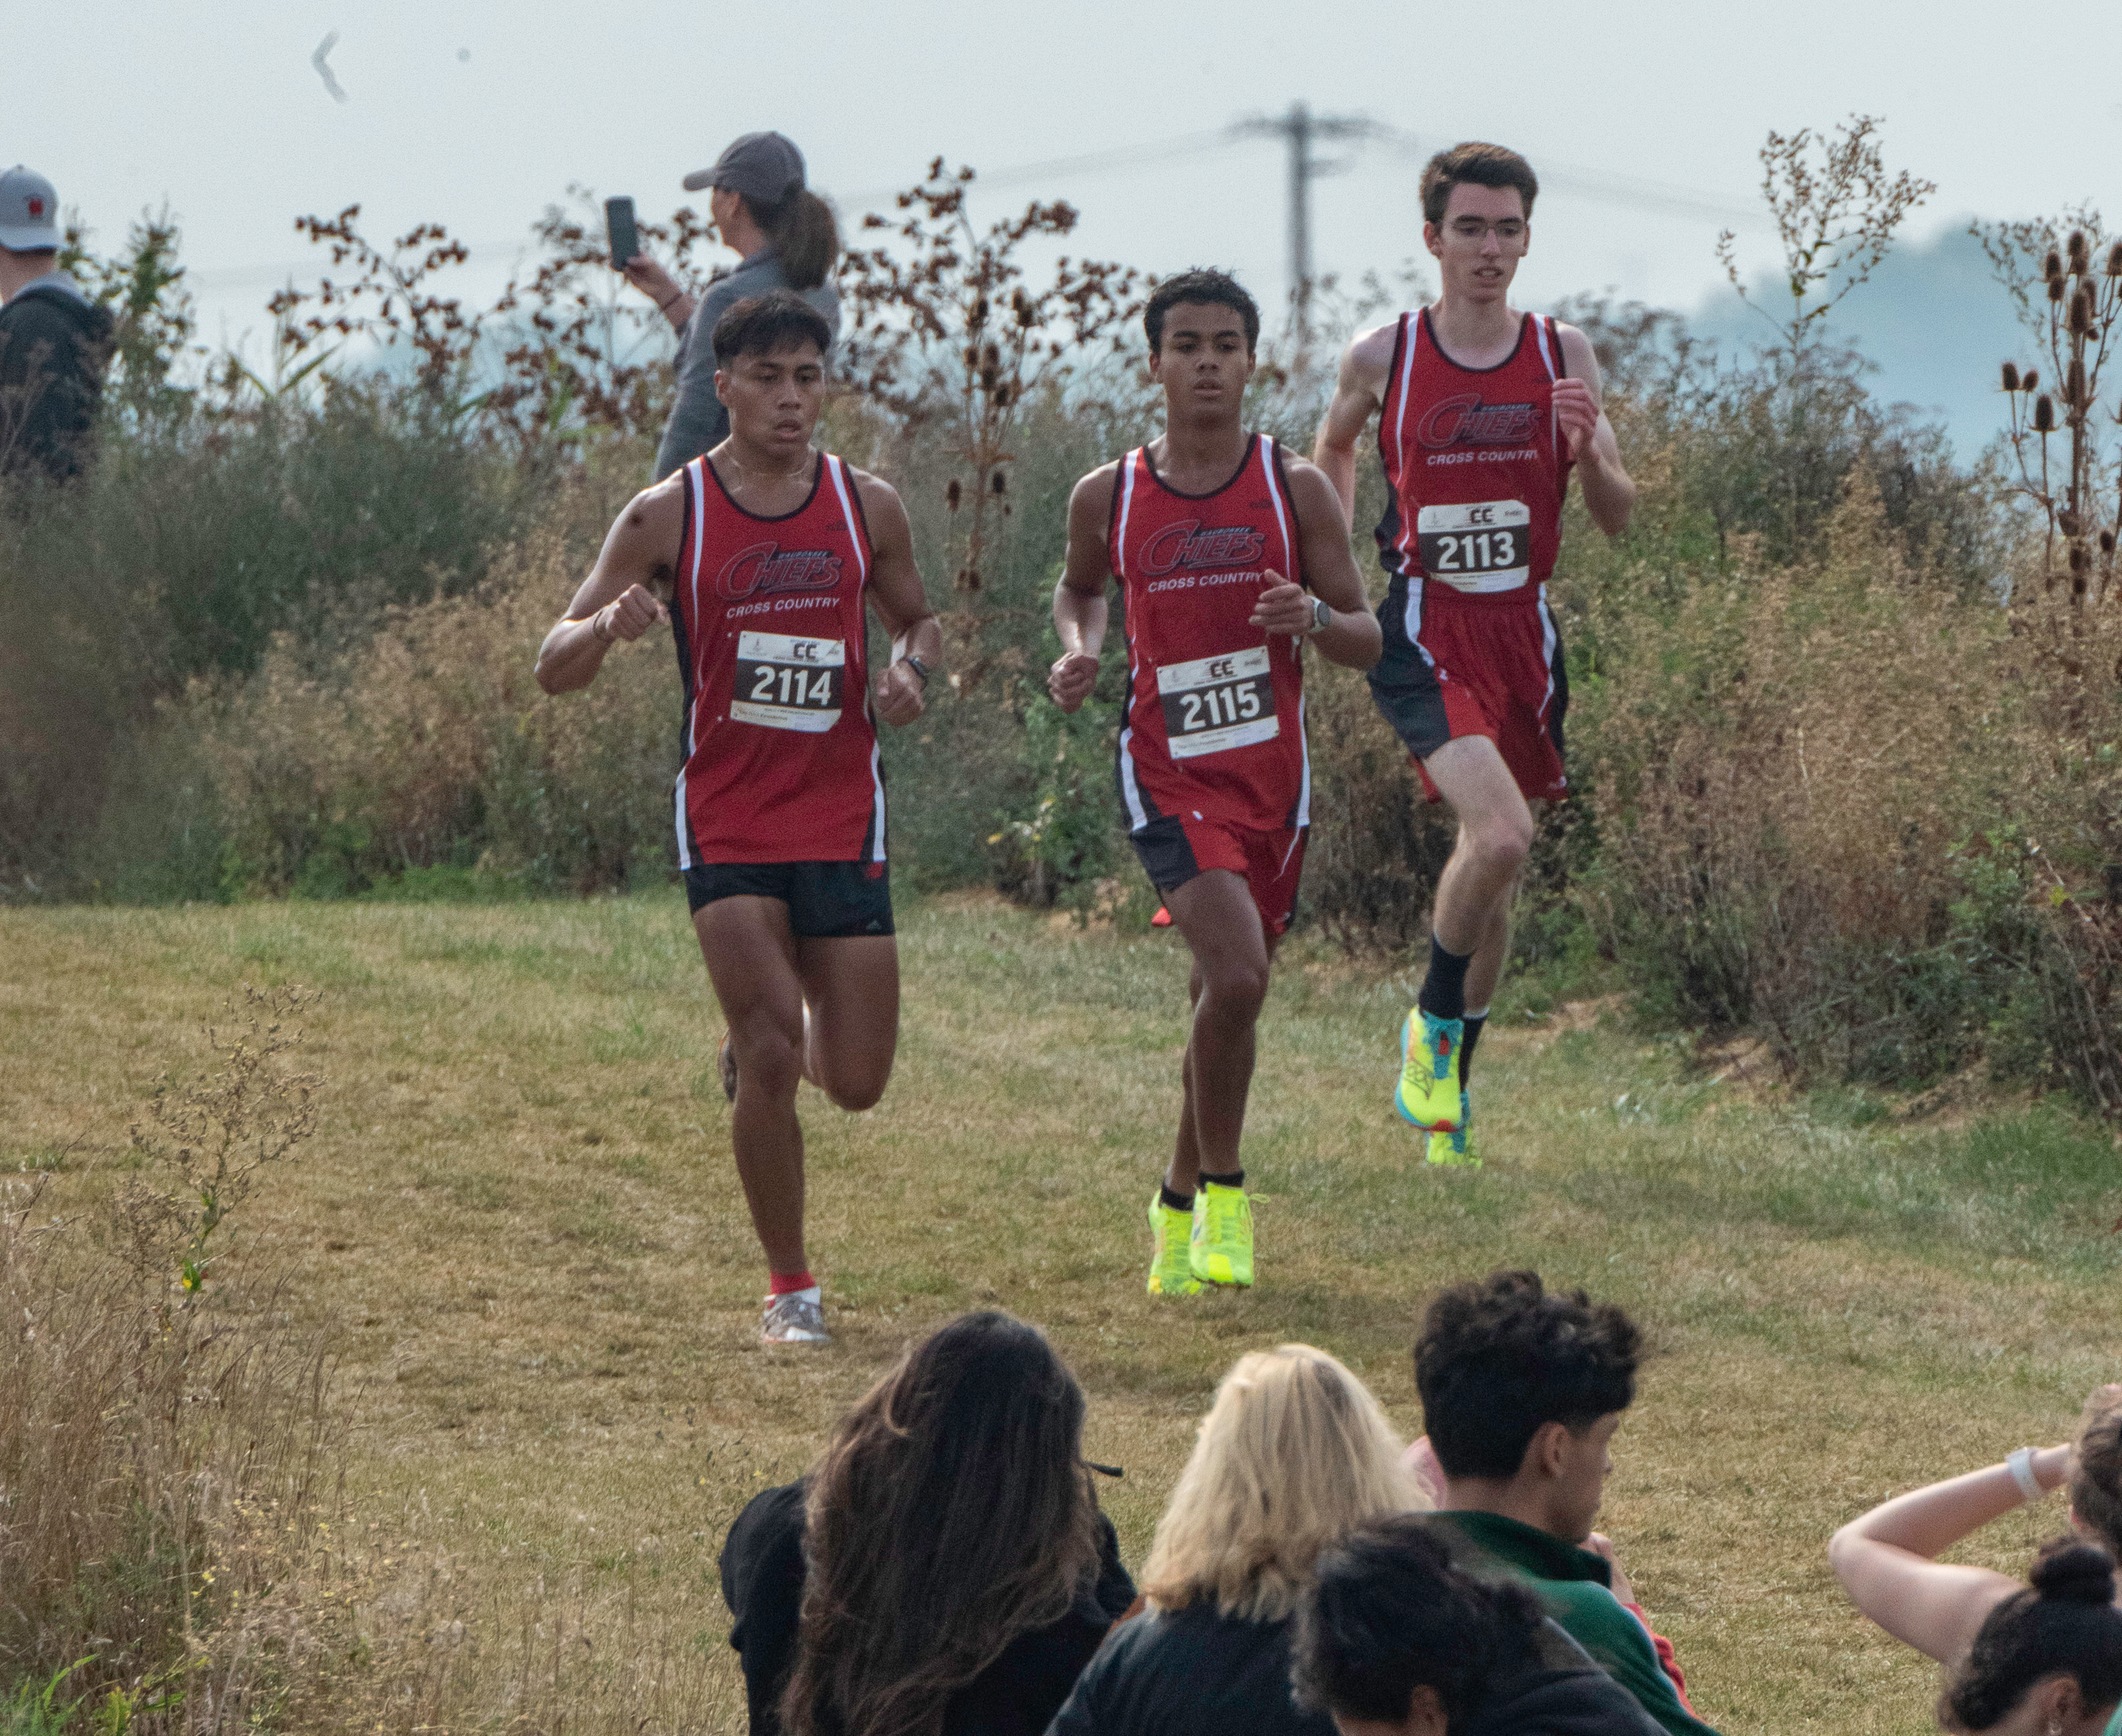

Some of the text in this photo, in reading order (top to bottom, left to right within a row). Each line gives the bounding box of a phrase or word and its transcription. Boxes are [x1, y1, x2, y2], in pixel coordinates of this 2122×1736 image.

[1426, 452, 1475, 466] CROSS
[1470, 509, 1493, 524] CC
[1137, 519, 1266, 576] CHIEFS
[1437, 531, 1515, 570] 2113
[1148, 572, 1263, 593] CROSS COUNTRY
[726, 597, 840, 619] CROSS COUNTRY
[793, 642, 818, 660] CC
[1210, 660, 1234, 678] CC
[750, 665, 831, 706] 2114
[1179, 681, 1260, 731] 2115
